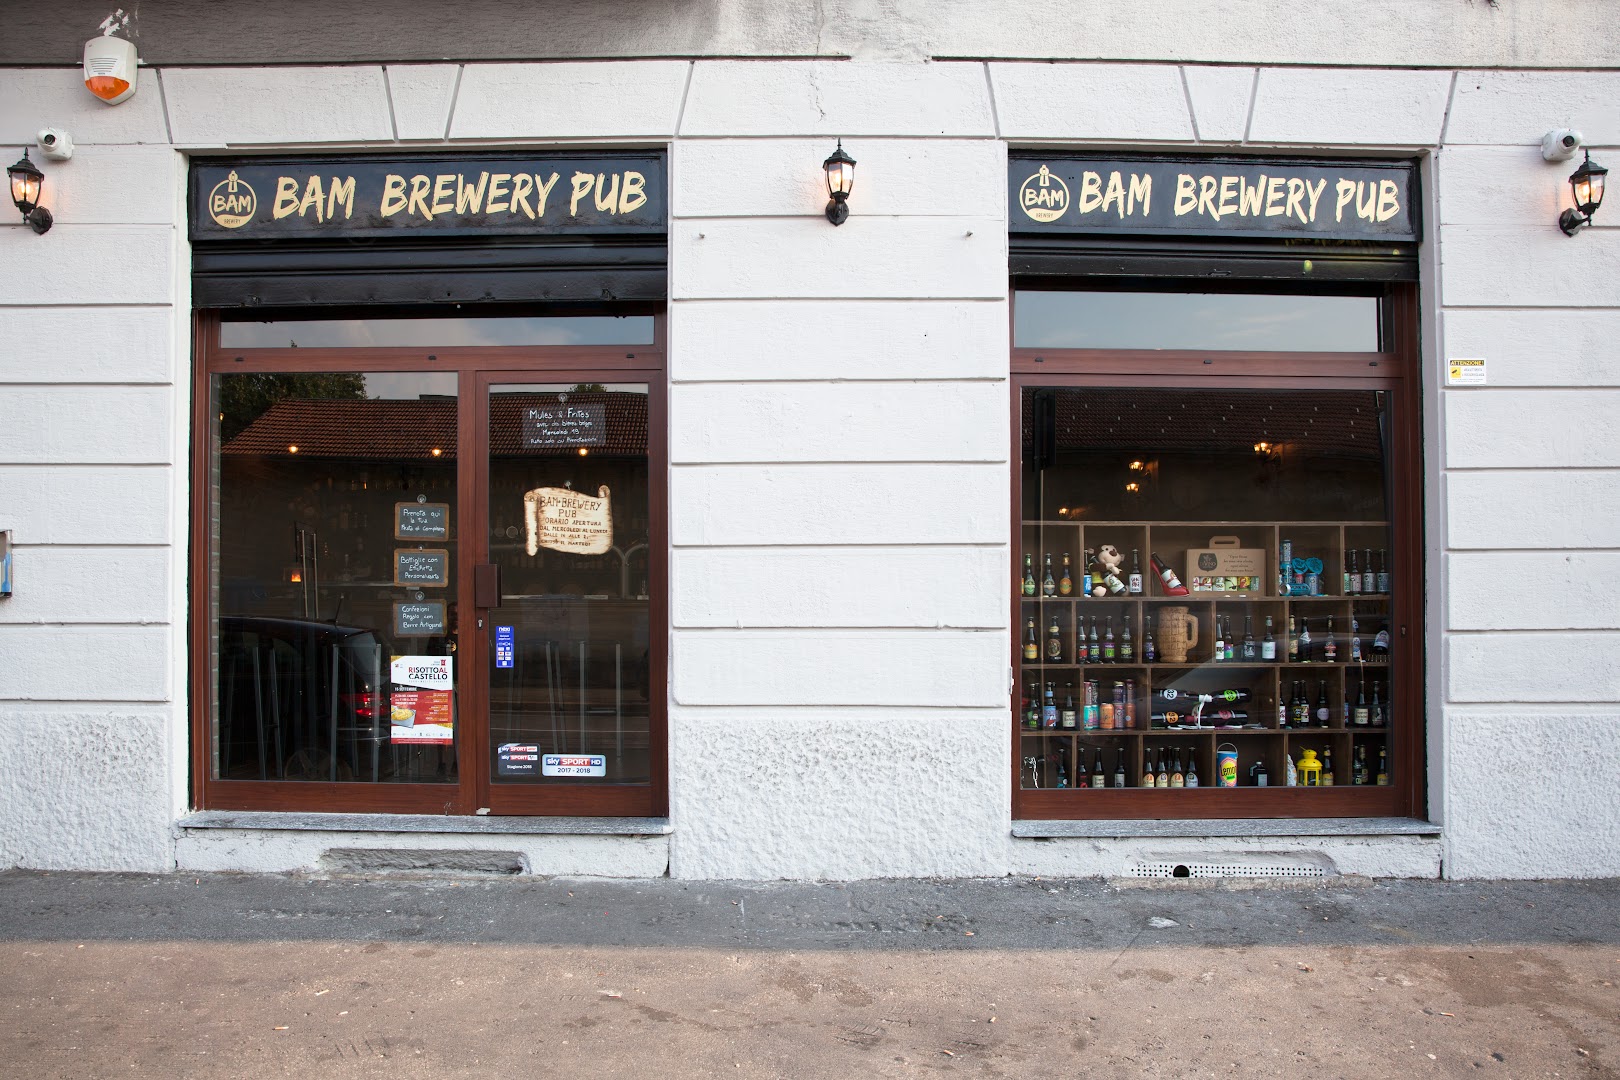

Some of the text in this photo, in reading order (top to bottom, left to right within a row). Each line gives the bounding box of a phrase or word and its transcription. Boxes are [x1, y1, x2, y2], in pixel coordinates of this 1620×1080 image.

[214, 194, 251, 214] BAM
[272, 170, 648, 223] BAM BREWERY PUB
[1025, 188, 1064, 208] BAM
[1079, 170, 1400, 225] BAM BREWERY PUB
[558, 508, 577, 518] PUB
[546, 757, 560, 766] sky
